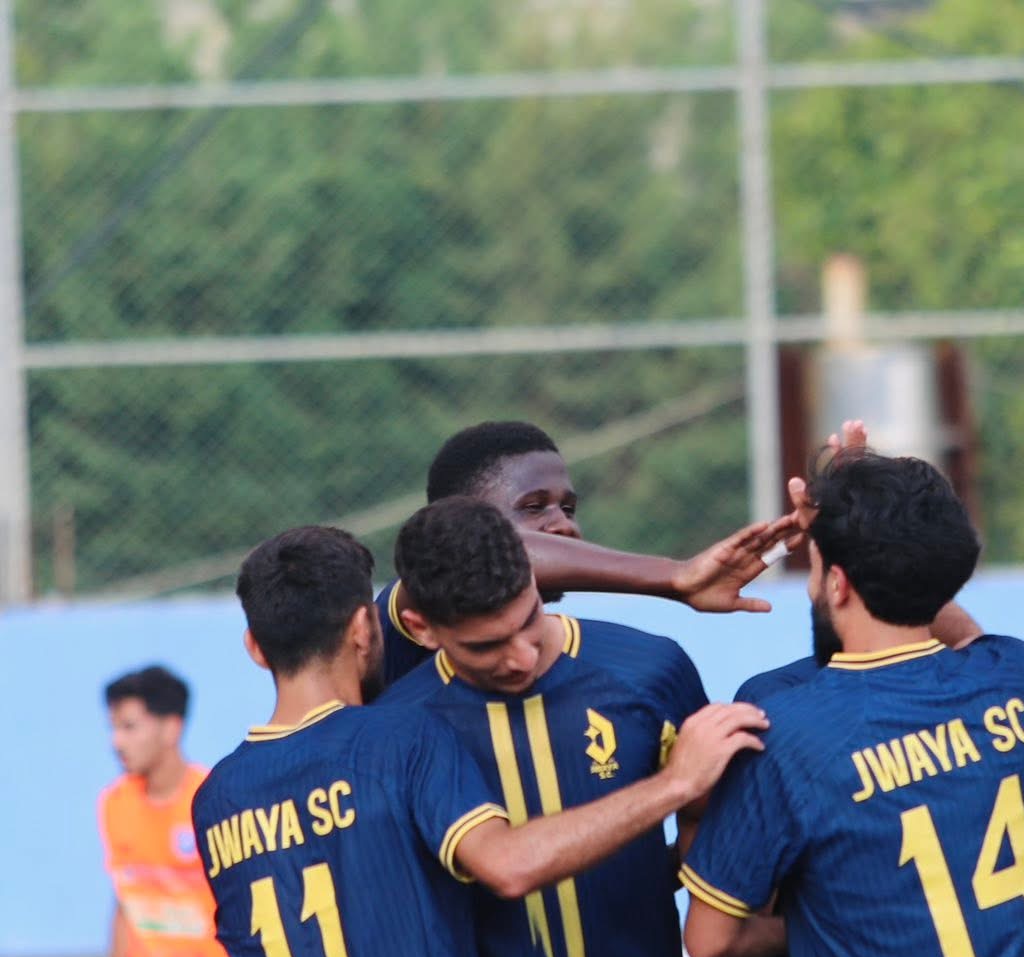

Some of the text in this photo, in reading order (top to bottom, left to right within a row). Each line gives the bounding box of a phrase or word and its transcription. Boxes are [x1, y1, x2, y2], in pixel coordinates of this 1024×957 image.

[851, 718, 982, 803] JWAYA
[206, 780, 356, 879] JWAYA SC
